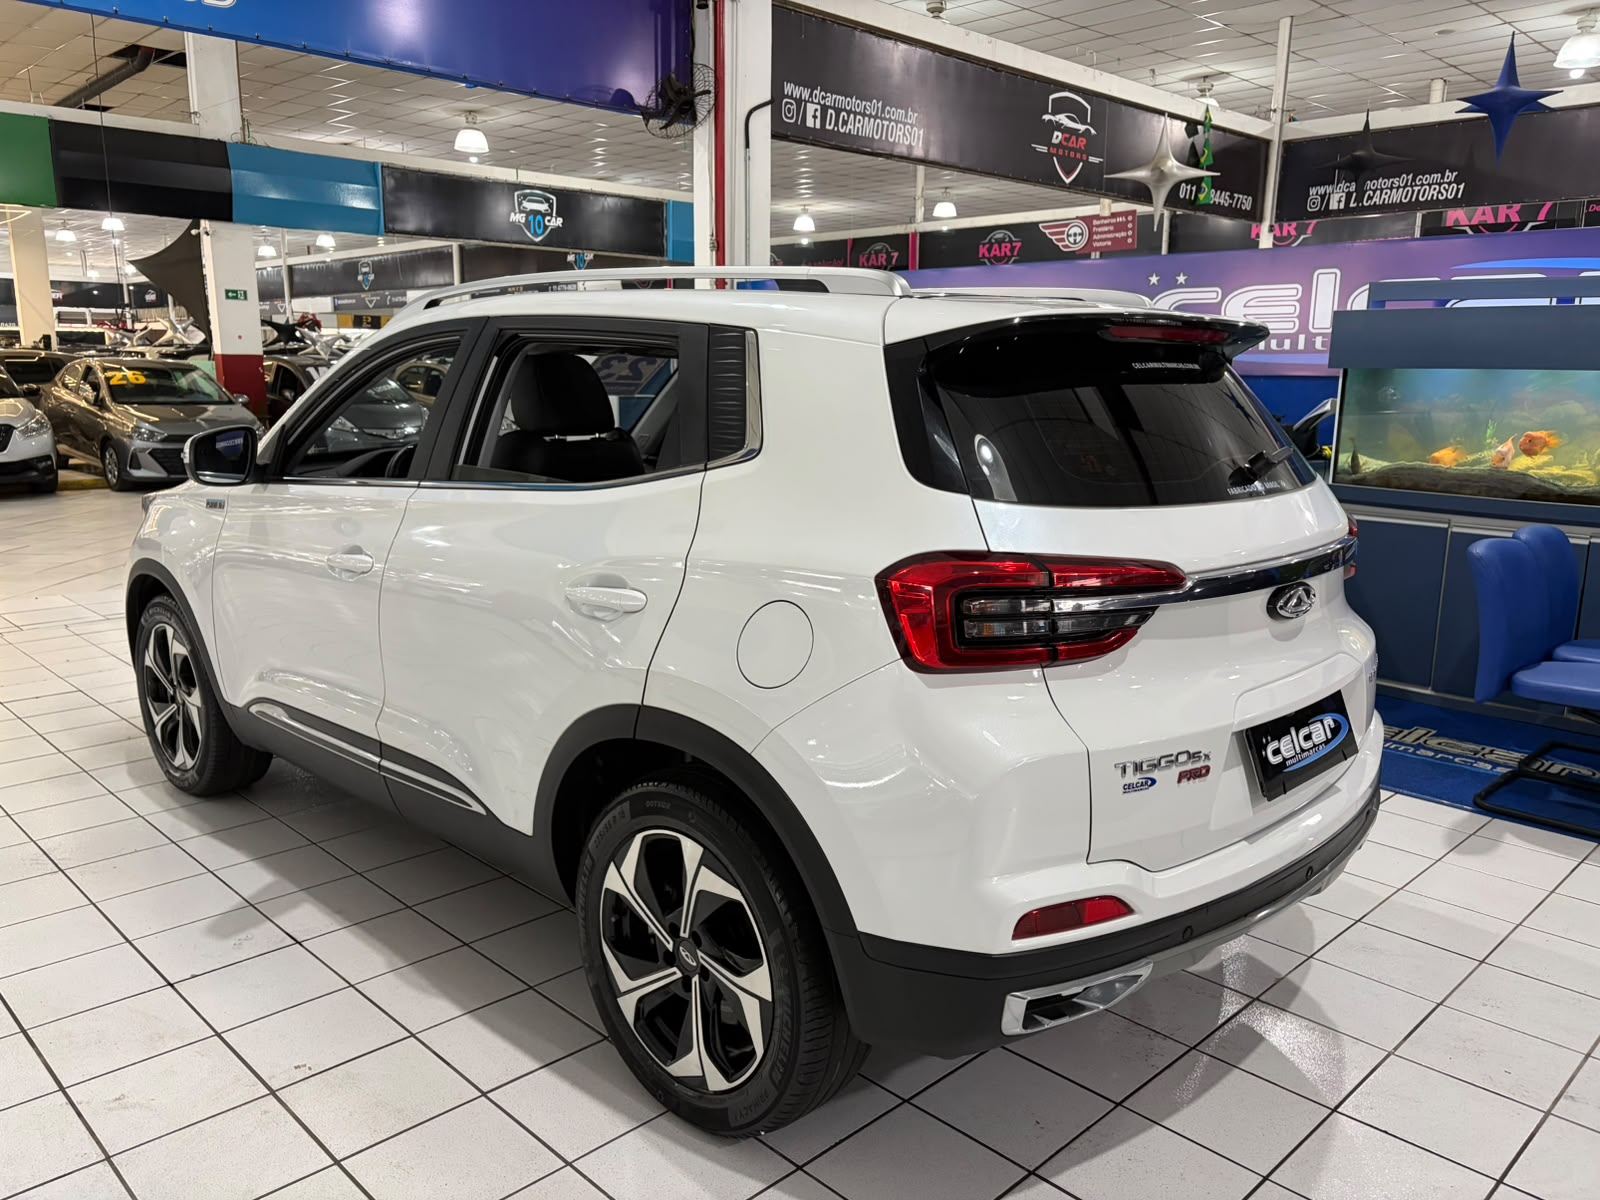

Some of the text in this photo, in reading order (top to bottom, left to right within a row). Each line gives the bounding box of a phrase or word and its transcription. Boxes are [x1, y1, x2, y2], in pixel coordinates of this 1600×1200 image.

[783, 80, 919, 124] www.dcarmotors01.com.br
[825, 108, 925, 148] D.CARMOTORS01
[1051, 131, 1087, 151] DCAR
[1049, 147, 1088, 161] MOTORS
[1178, 182, 1197, 200] 011
[509, 211, 564, 235] MG 10 CAR
[110, 370, 147, 386] 26
[1265, 715, 1337, 766] celcar
[1285, 743, 1327, 767] multimarcas
[1176, 764, 1211, 785] PRO
[1122, 780, 1149, 791] CELCAR
